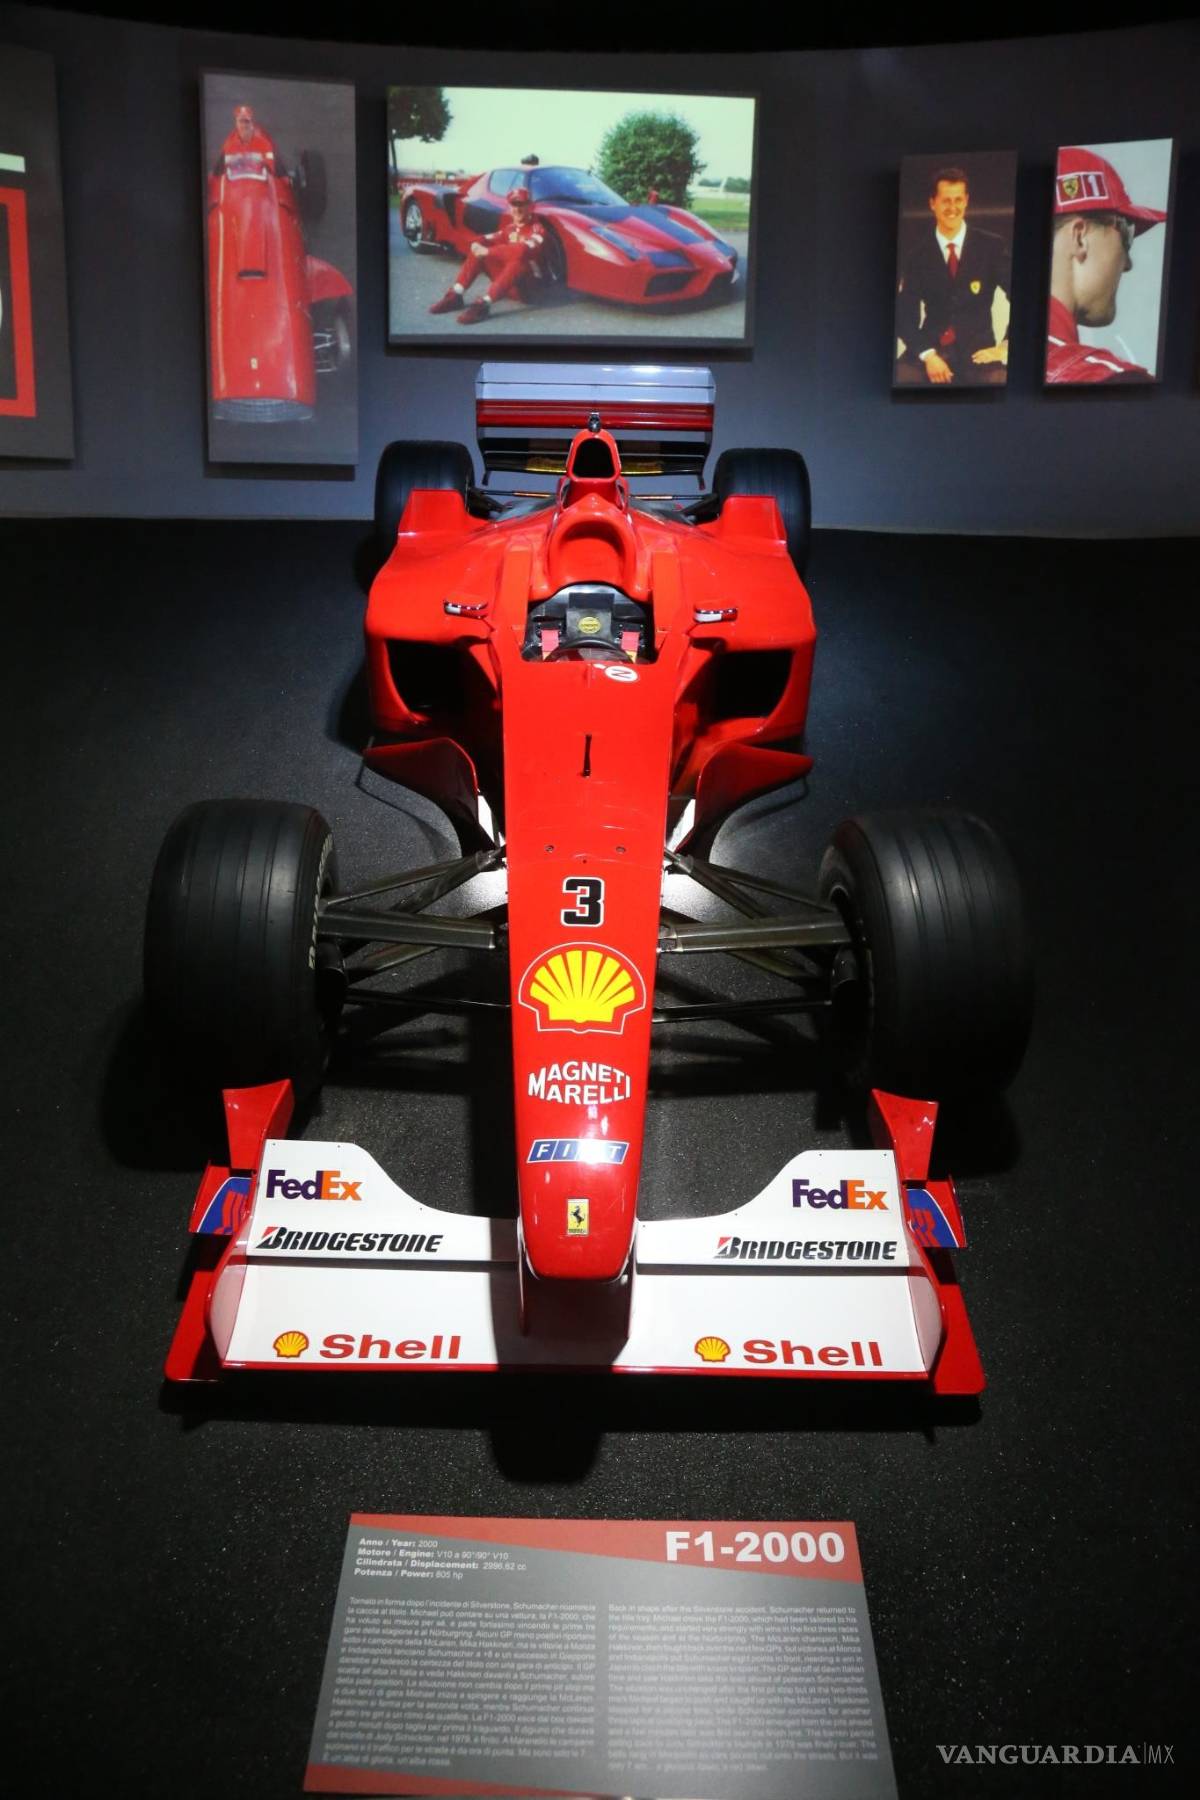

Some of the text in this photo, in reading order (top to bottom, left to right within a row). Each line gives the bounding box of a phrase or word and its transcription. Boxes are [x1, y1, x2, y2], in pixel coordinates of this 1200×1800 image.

[1088, 174, 1100, 197] 1
[561, 876, 605, 927] 3
[528, 1061, 631, 1088] MAGNETI
[528, 1080, 631, 1105] MARELLI
[534, 1142, 624, 1160] FIT
[266, 1169, 362, 1201] FedEx
[792, 1178, 890, 1211] FedEx
[256, 1226, 444, 1254] BRIDGESTONE
[713, 1235, 897, 1261] BRIDGESTONE
[319, 1333, 462, 1361] Shell
[743, 1339, 884, 1368] Shell
[357, 1547, 391, 1557] Motore
[399, 1549, 434, 1559] Engine:
[436, 1550, 453, 1559] V10
[492, 1551, 509, 1561] V10
[359, 1537, 383, 1547] Anno
[391, 1538, 416, 1548] Year:
[418, 1539, 439, 1548] 2000
[666, 1531, 845, 1563] F1-2000
[354, 1567, 393, 1577] Potenza
[400, 1569, 433, 1579] Power:
[355, 1557, 403, 1567] Cilindrata
[410, 1559, 479, 1570] Displacement:
